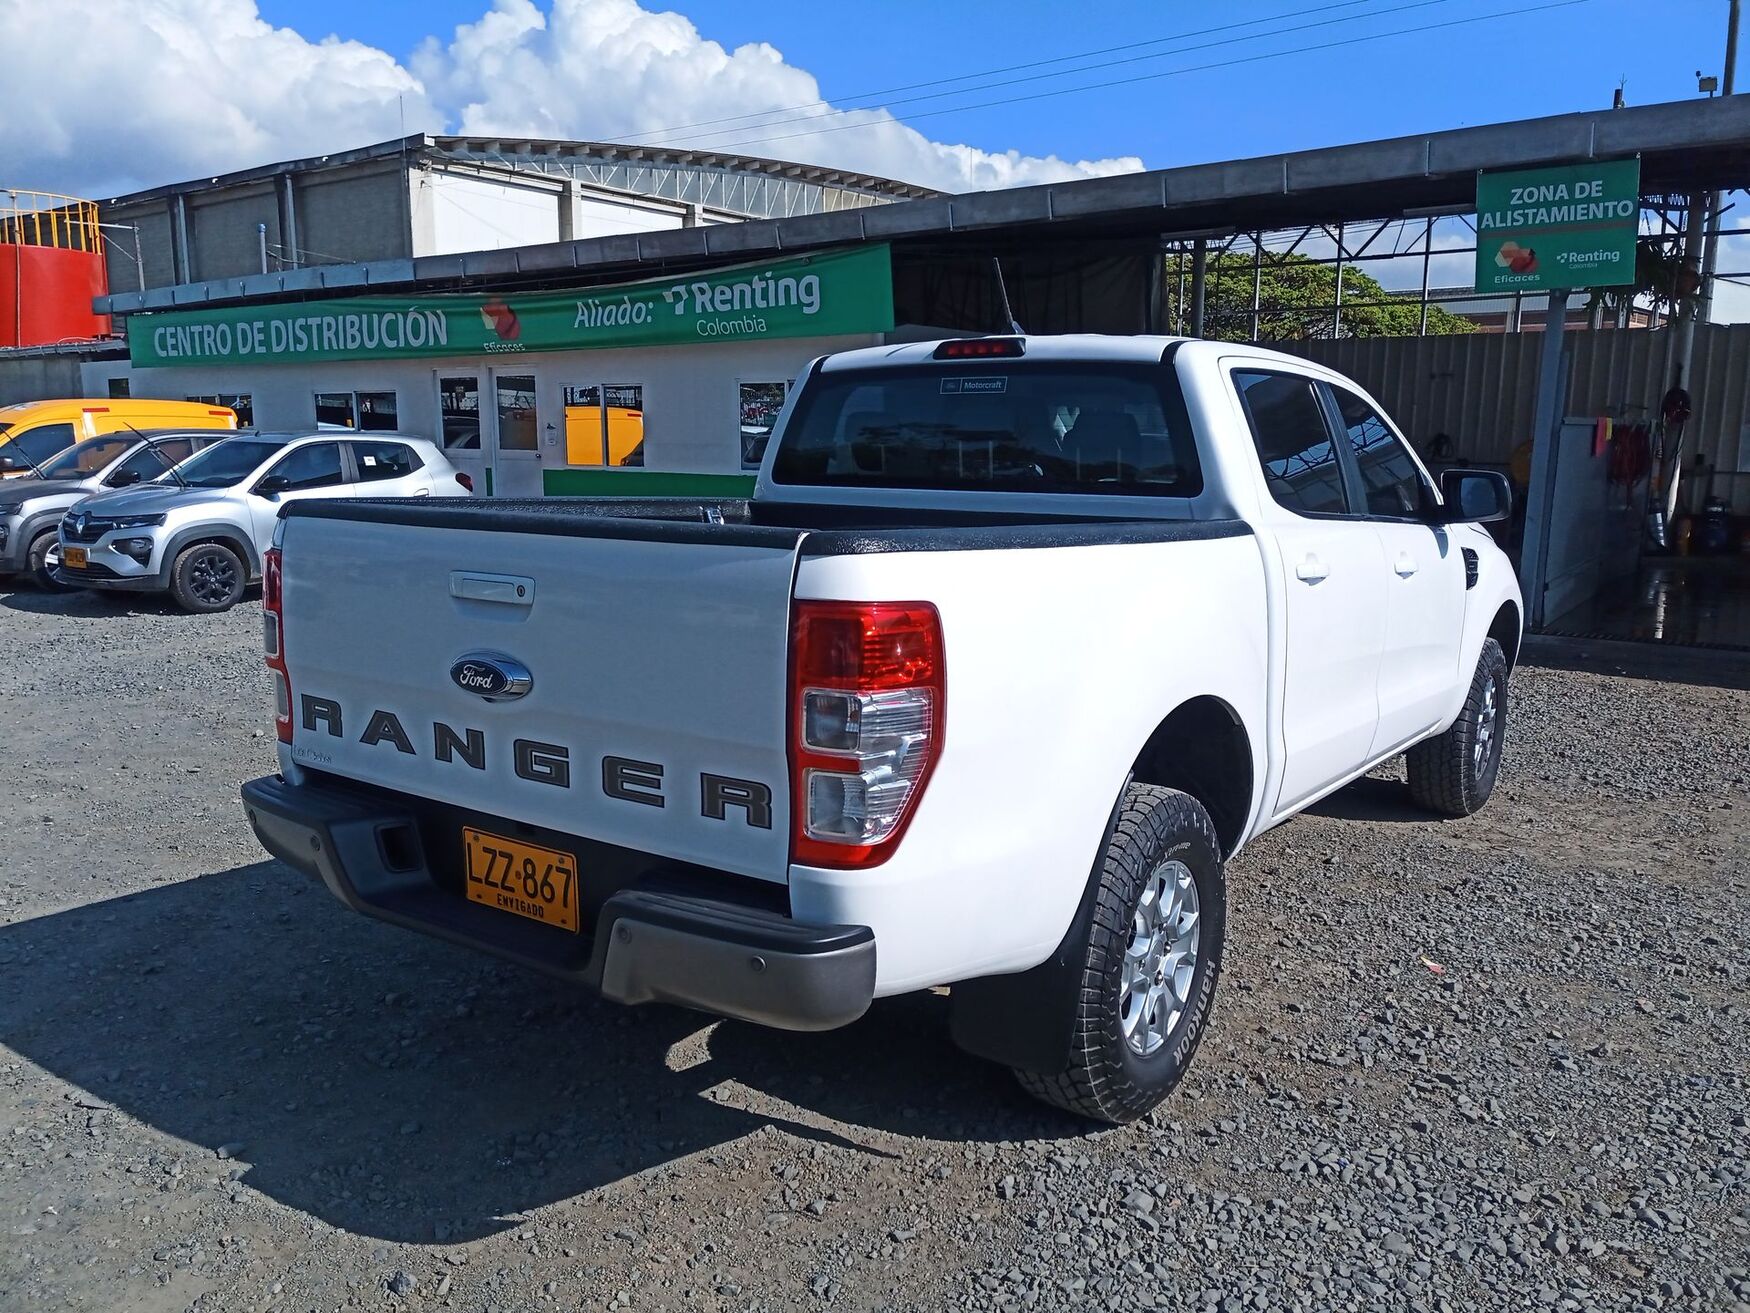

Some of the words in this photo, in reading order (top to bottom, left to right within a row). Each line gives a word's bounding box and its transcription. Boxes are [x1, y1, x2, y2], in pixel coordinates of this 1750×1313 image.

[1510, 183, 1569, 205] ZONA
[1574, 180, 1603, 199] DE
[1481, 200, 1634, 229] ALISTAMIENTO
[1569, 249, 1620, 263] Renting
[1494, 273, 1541, 284] Eficaces
[692, 271, 820, 314] Renting
[574, 296, 654, 328] Aliado:
[154, 323, 232, 358] CENTRO
[236, 321, 267, 354] DE
[270, 306, 448, 353] DISTRIBUCIÓN
[696, 315, 767, 336] Colombia
[964, 381, 1002, 390] Motorcraft
[460, 664, 494, 689] Ford
[301, 694, 773, 830] RANGER
[496, 893, 545, 919] ENVIGADO
